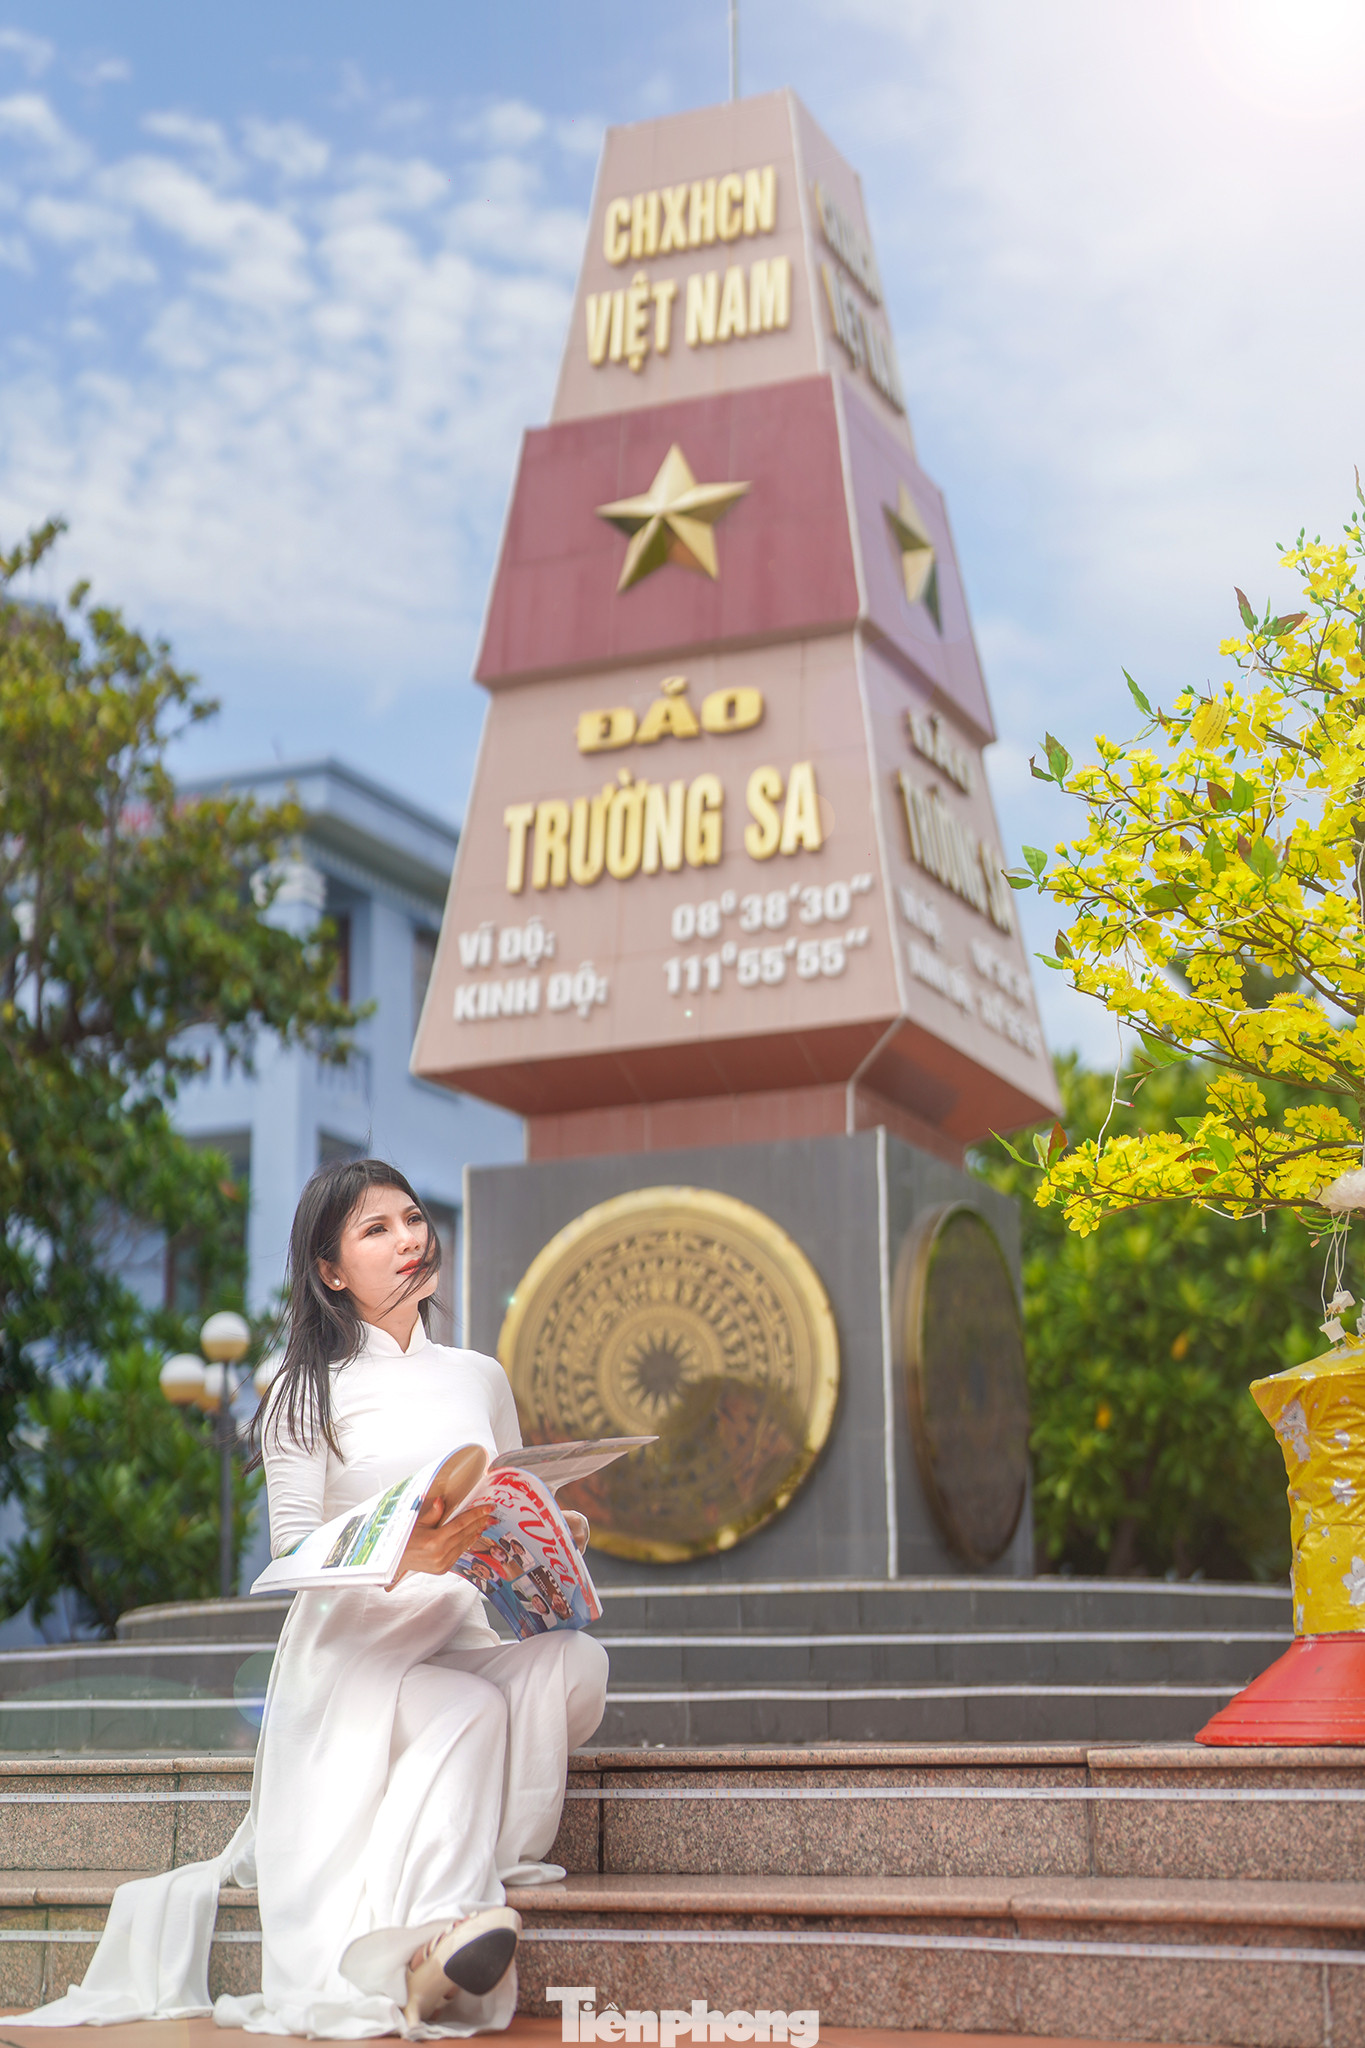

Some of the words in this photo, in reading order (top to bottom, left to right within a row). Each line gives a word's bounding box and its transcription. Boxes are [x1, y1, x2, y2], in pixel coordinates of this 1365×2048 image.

[603, 164, 776, 267] CHXHCN
[586, 269, 677, 373] VIỆT
[685, 255, 791, 347] NAM
[575, 675, 764, 755] ĐẢO
[503, 767, 723, 894] TRƯỜNG
[744, 760, 822, 861] SA
[458, 921, 496, 970] VĨ
[453, 976, 541, 1022] KINH
[517, 1505, 576, 1589] Việt
